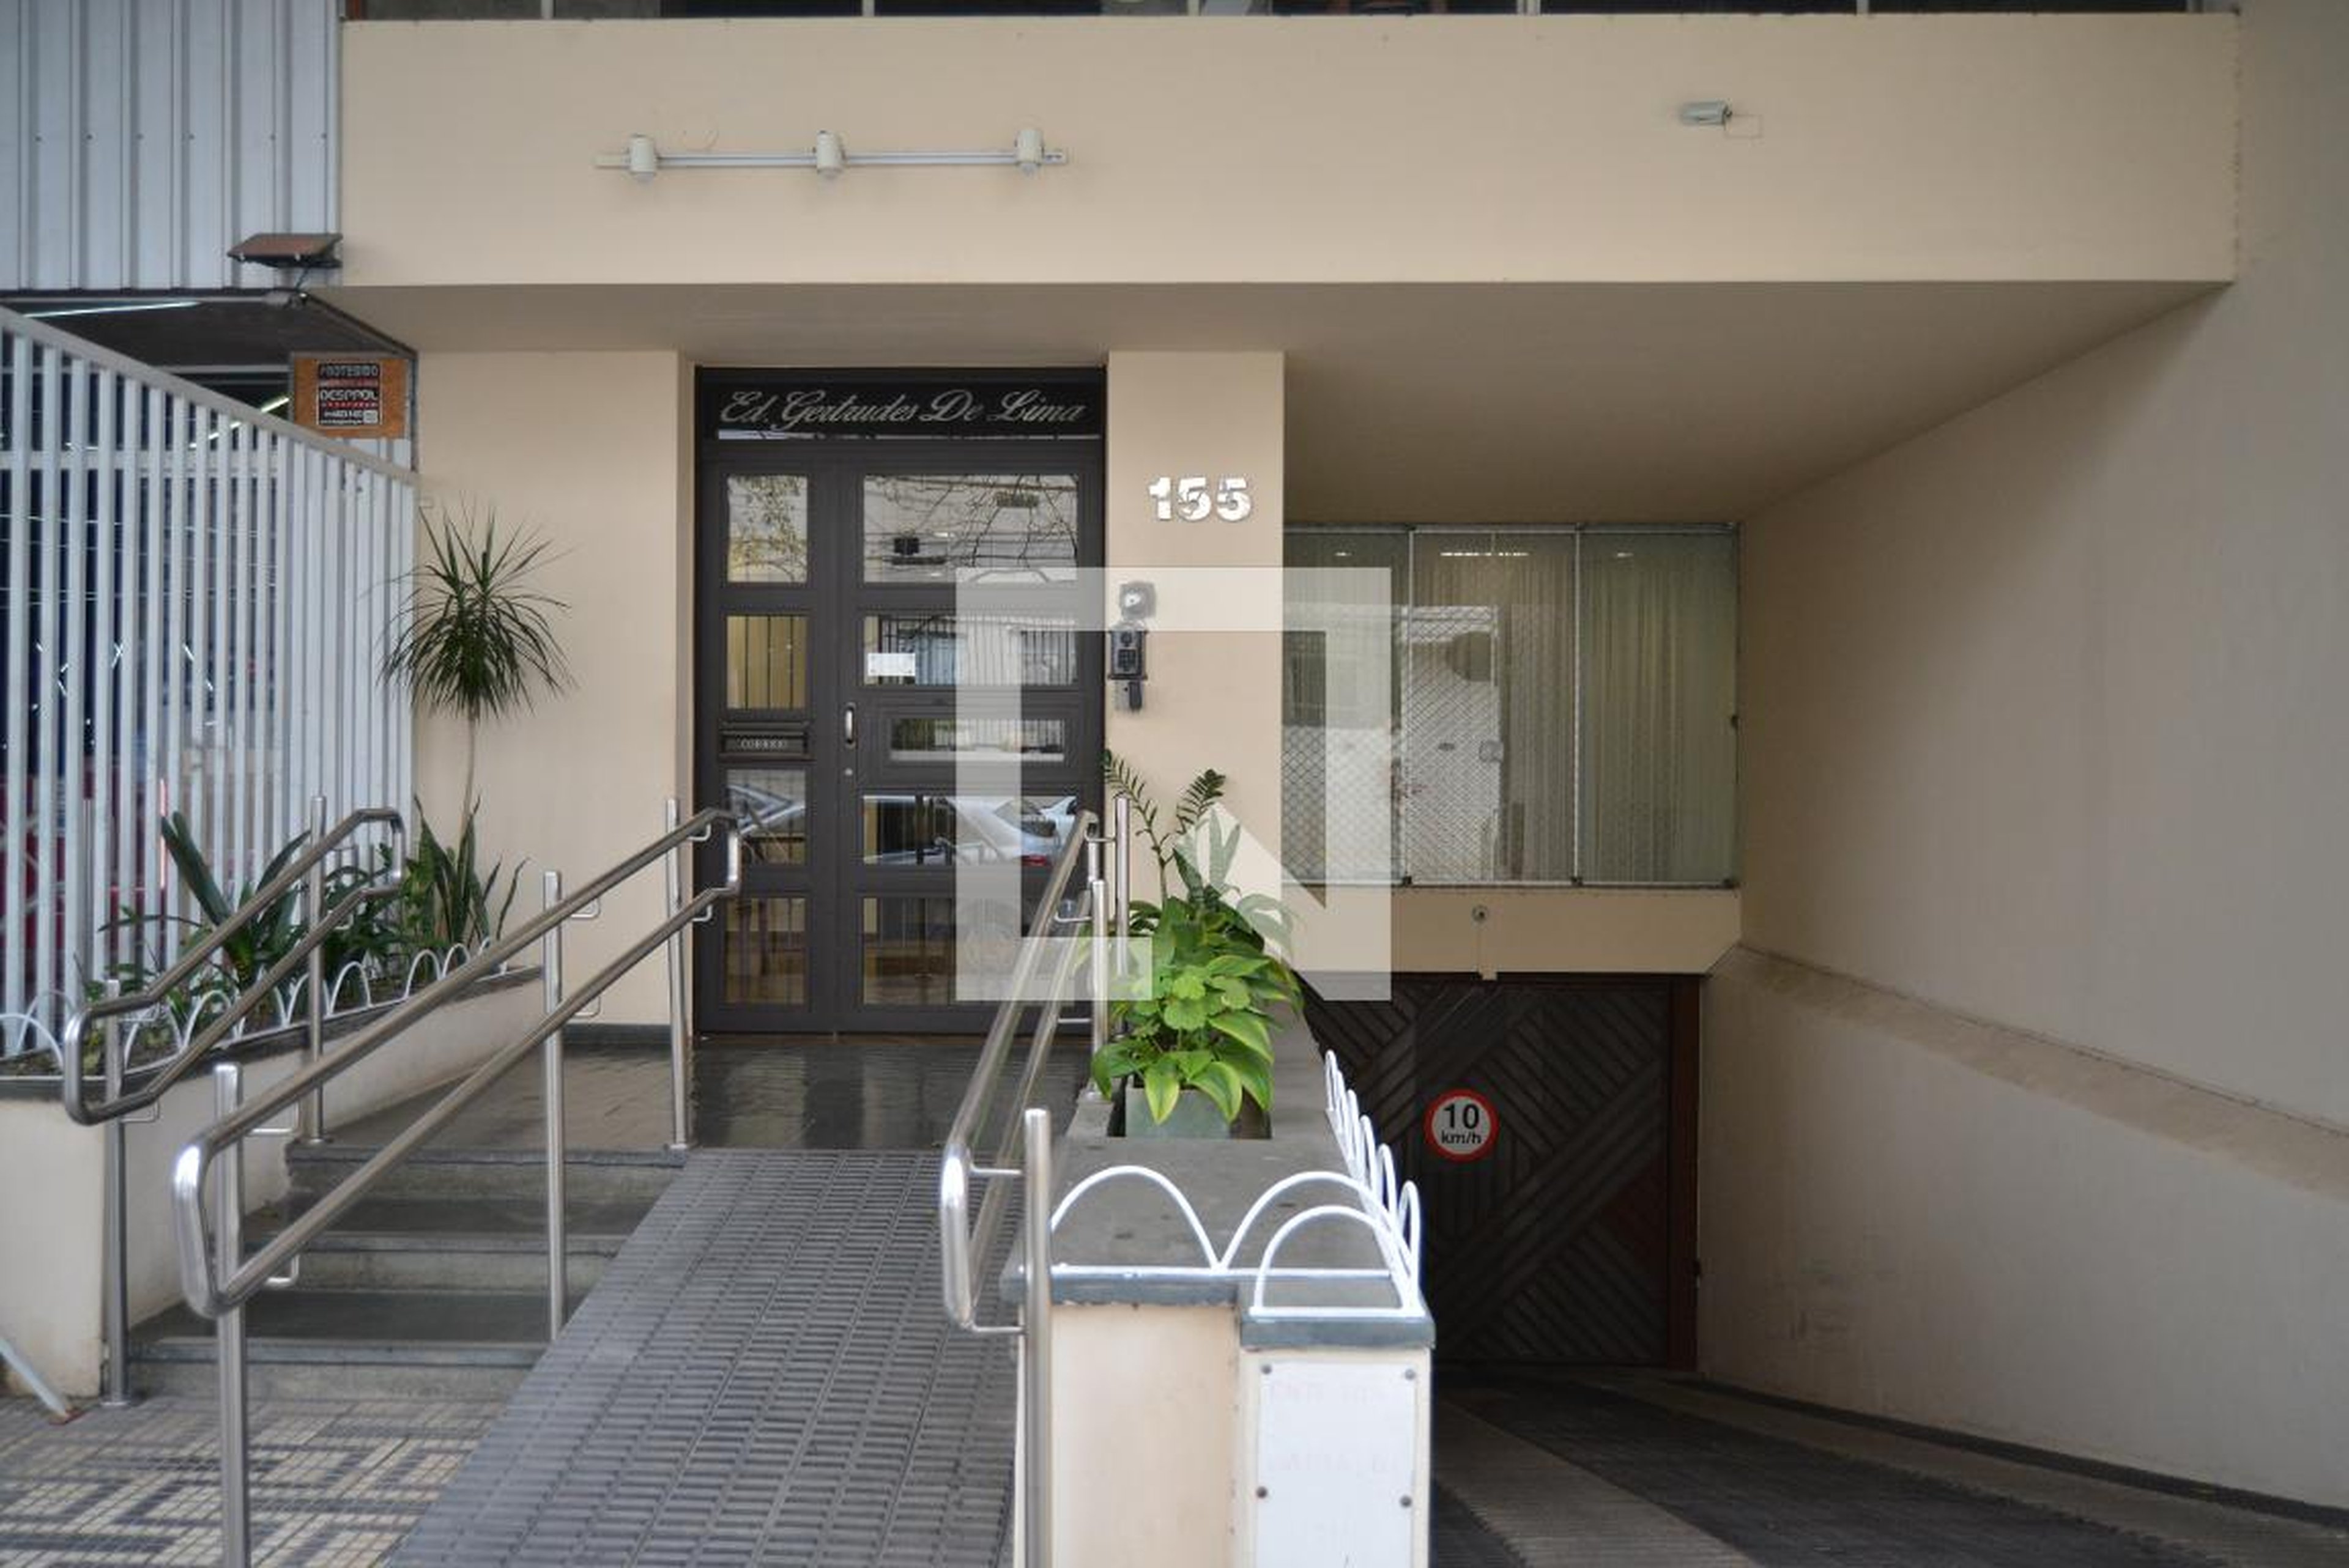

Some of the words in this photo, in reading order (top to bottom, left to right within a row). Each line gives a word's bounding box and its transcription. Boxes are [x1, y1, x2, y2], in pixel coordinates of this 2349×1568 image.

[770, 390, 919, 431] Gertrudes
[918, 389, 984, 421] De
[987, 389, 1088, 421] Lima
[1148, 477, 1252, 520] 155
[1443, 1103, 1479, 1130] 10
[1441, 1130, 1482, 1144] km/h
